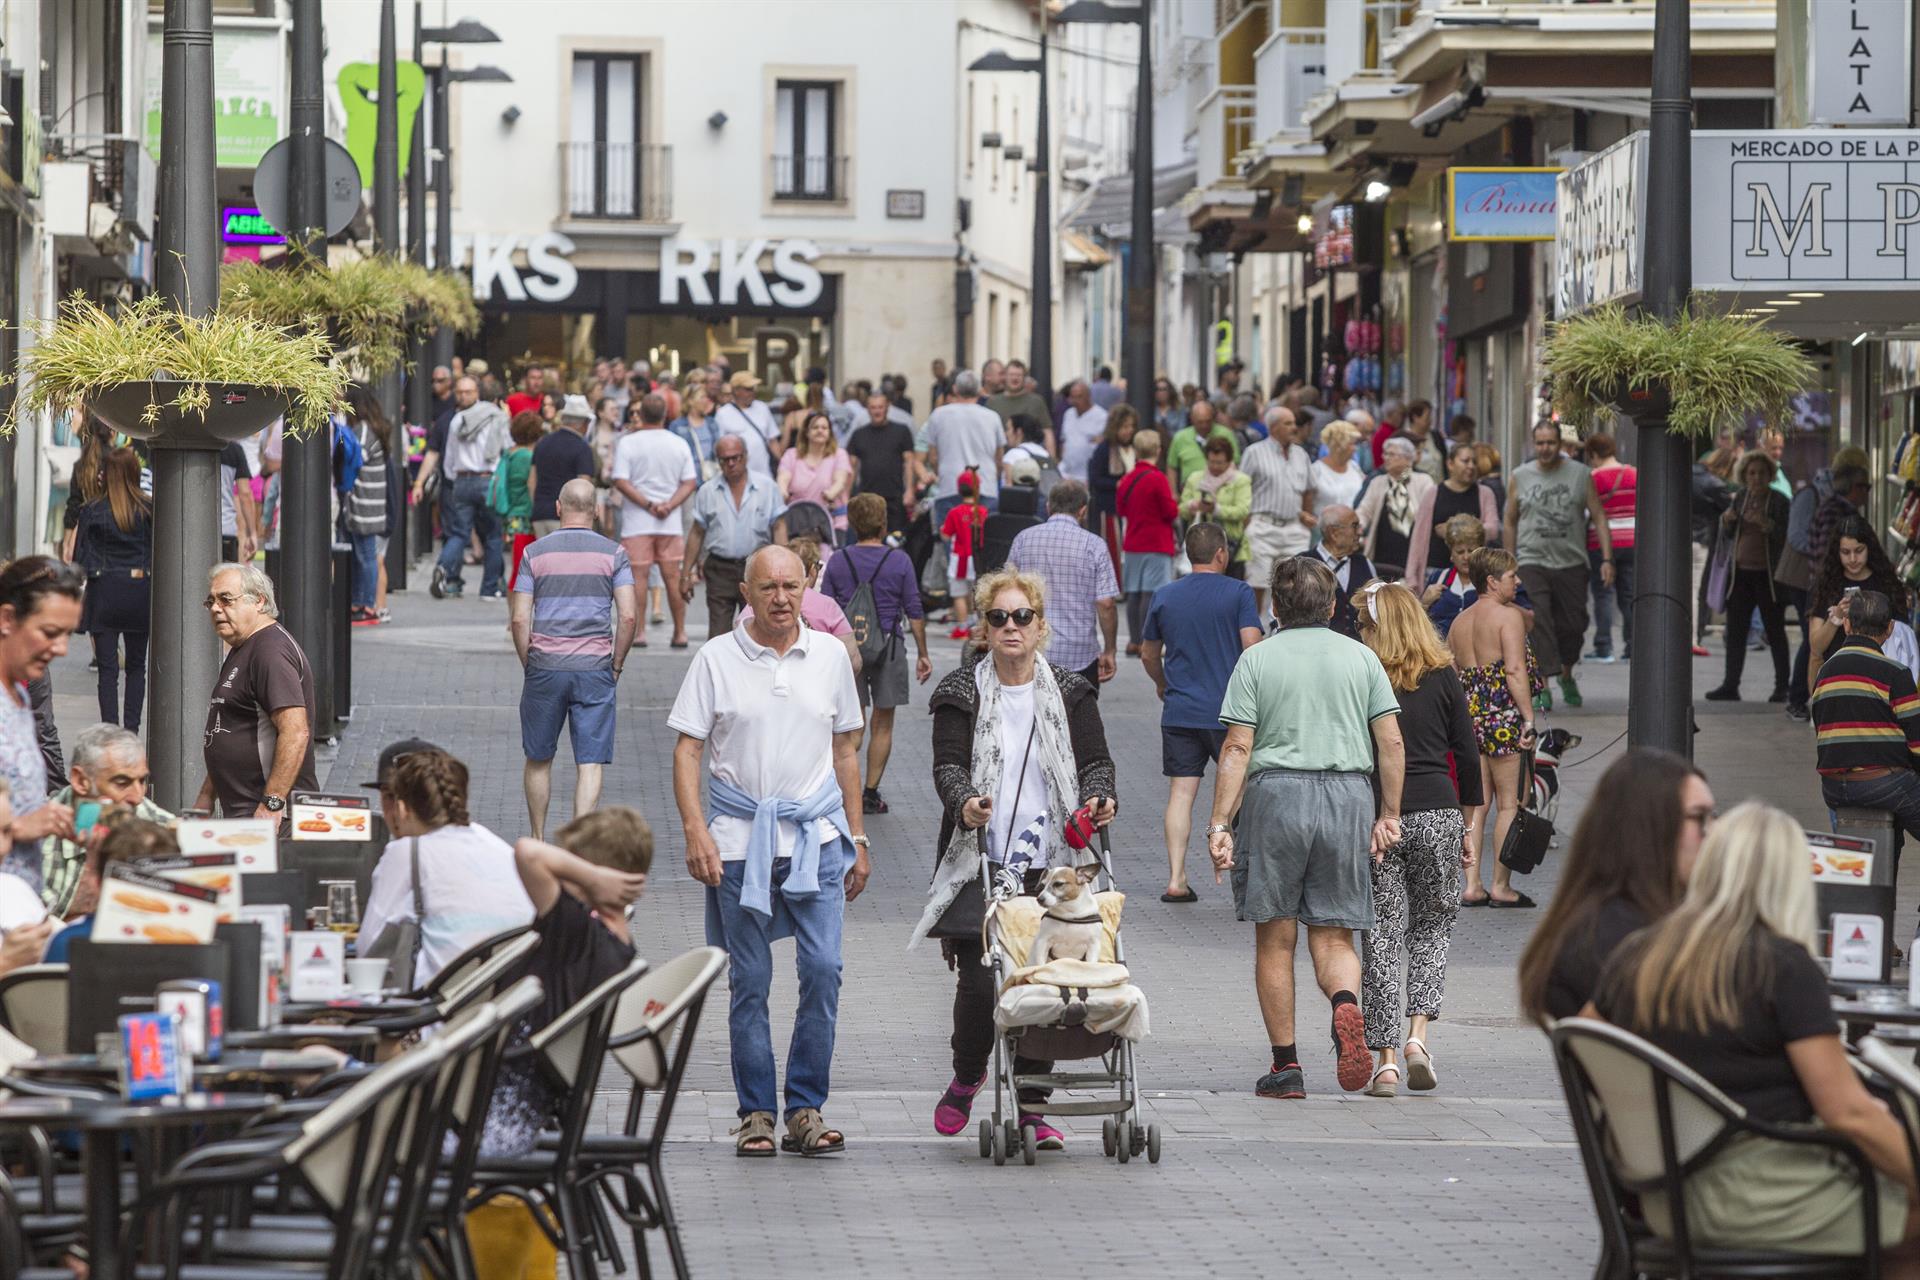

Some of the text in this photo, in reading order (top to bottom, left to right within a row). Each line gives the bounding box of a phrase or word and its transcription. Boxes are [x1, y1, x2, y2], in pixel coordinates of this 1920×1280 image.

[1848, 0, 1872, 113] LATA
[1731, 141, 1833, 157] MERCADO
[1841, 141, 1867, 156] DE
[1875, 141, 1899, 156] LA
[226, 213, 277, 235] ABIE
[1745, 182, 1832, 257] M
[659, 237, 824, 308] RKS
